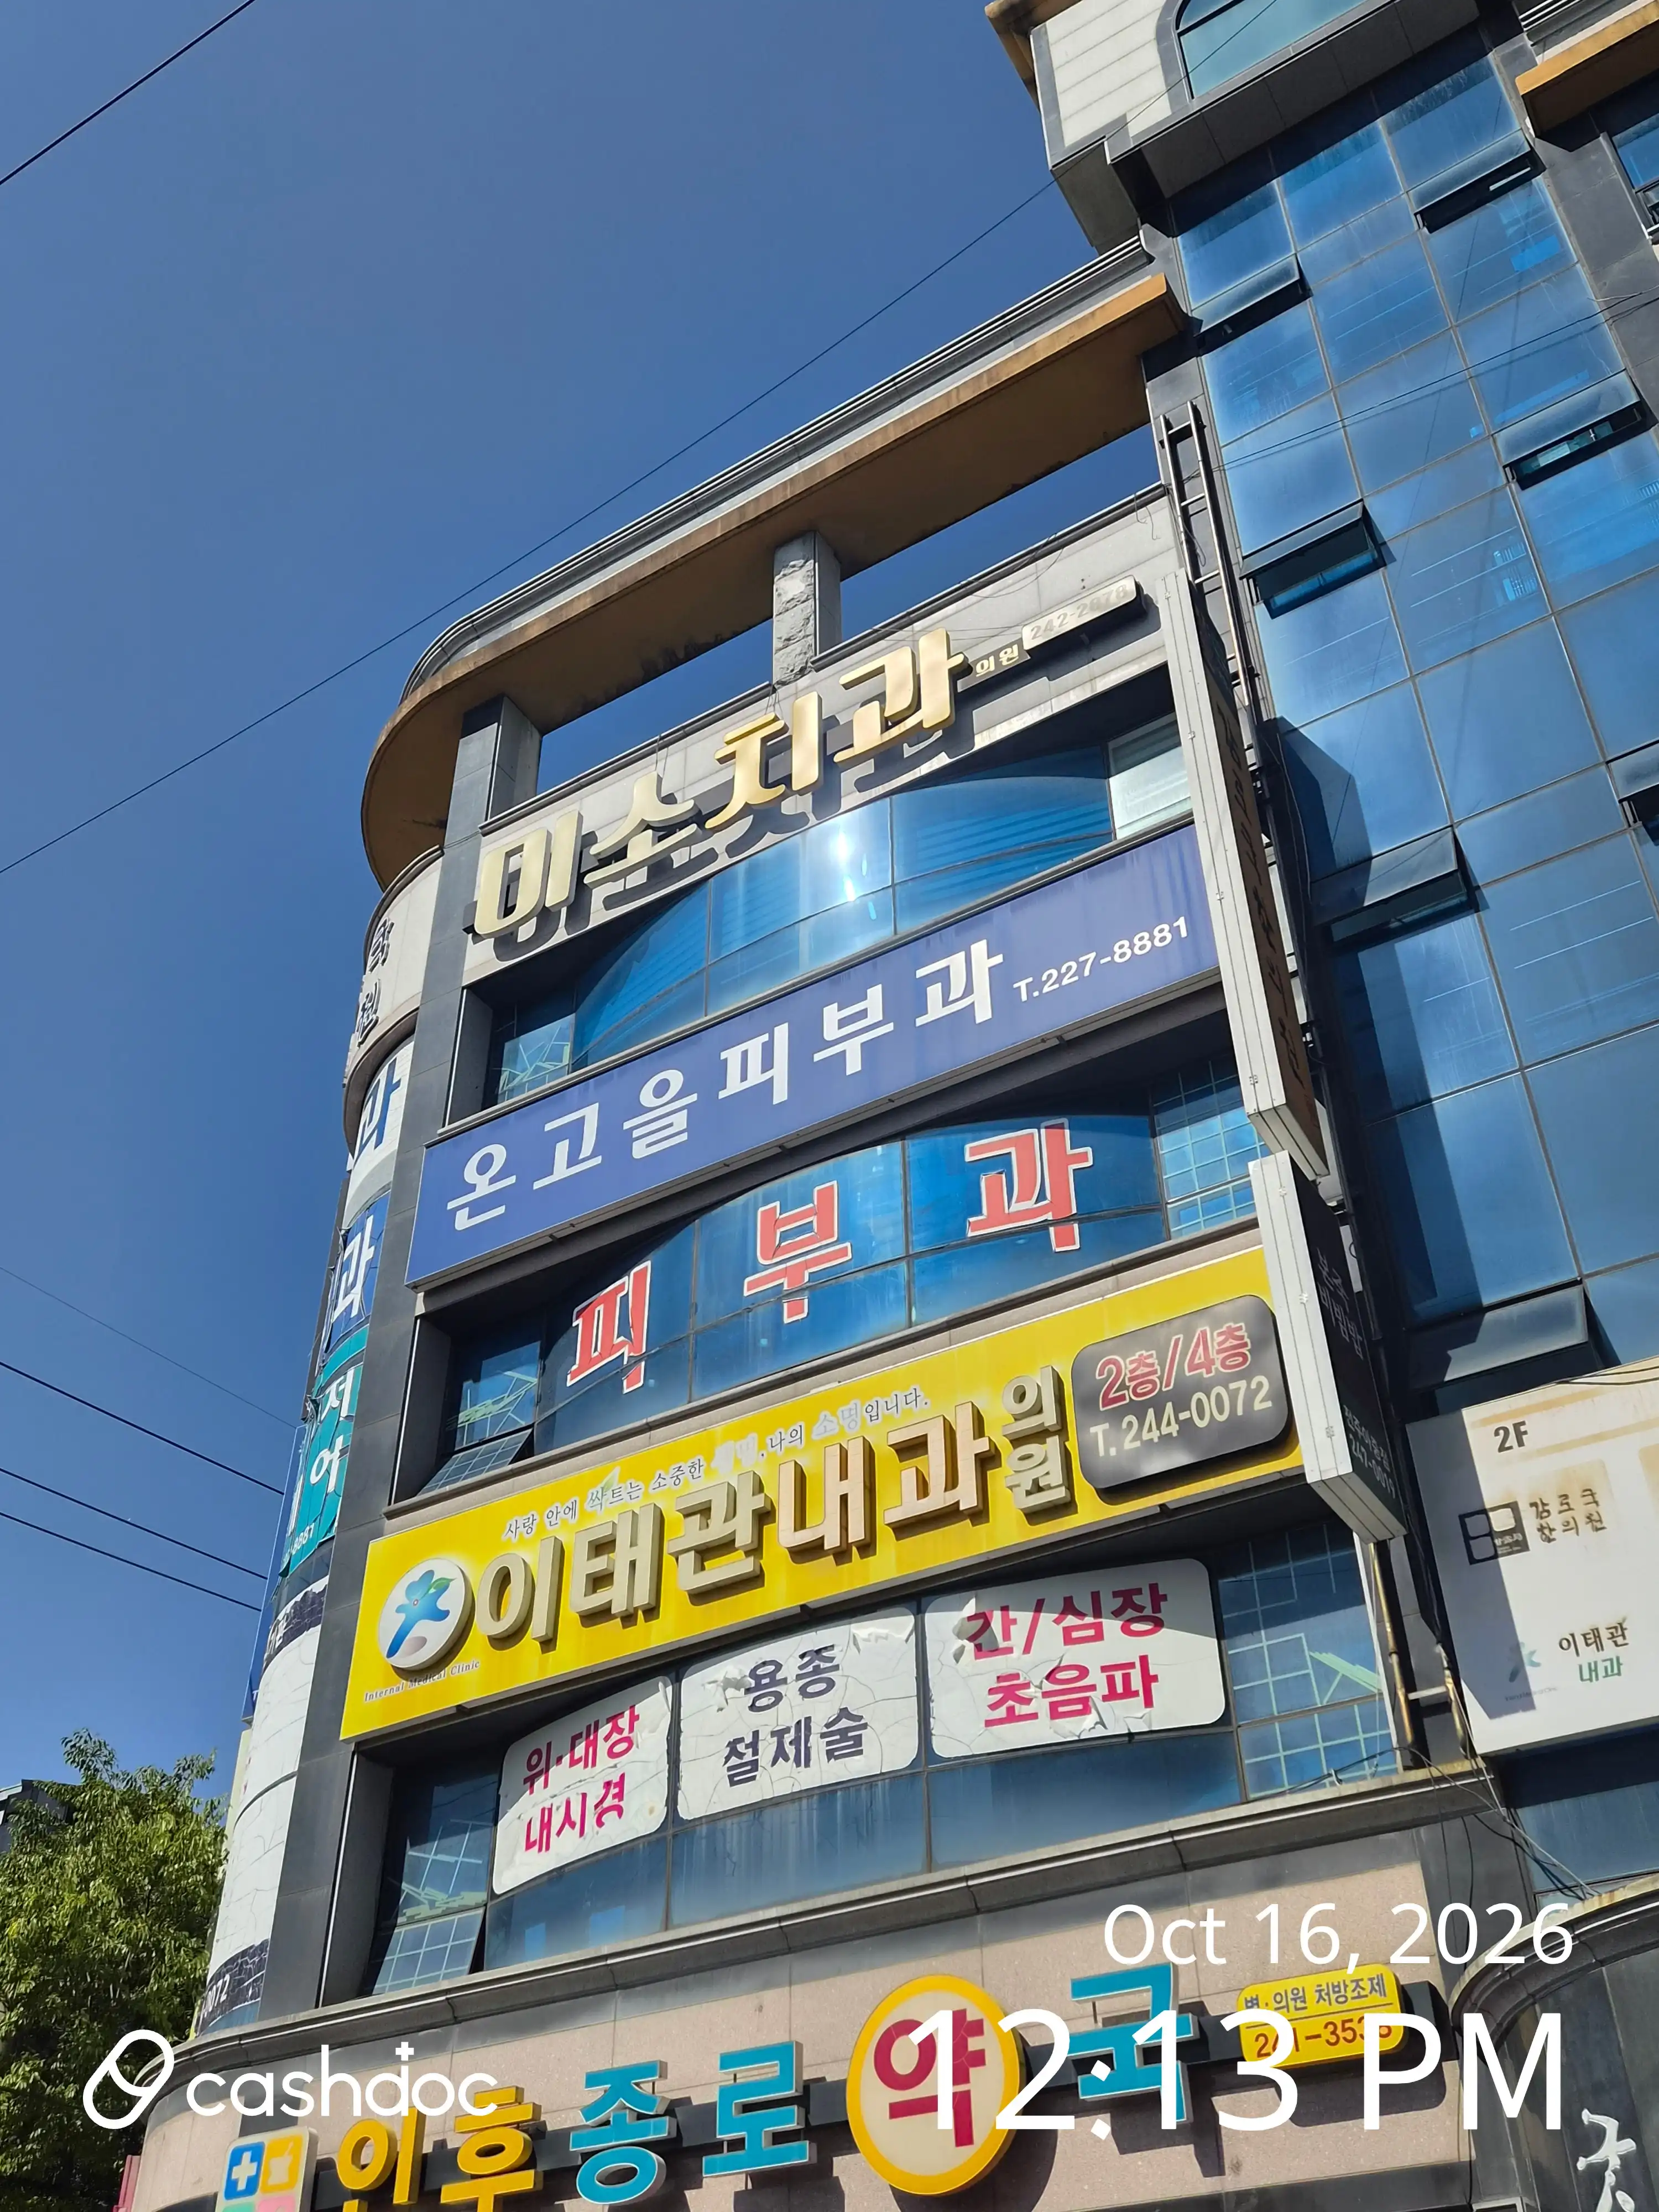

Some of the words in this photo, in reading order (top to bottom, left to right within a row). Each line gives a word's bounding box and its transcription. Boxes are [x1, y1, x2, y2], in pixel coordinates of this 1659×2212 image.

[473, 627, 974, 938] 미소치과
[975, 645, 1019, 677] 의원
[447, 938, 1004, 1232] 온고을피부과
[566, 1118, 1093, 1394] 피부과
[1096, 1321, 1251, 1411] 2층/4층
[1494, 1420, 1528, 1453] 2F
[474, 1402, 997, 1642] 이태관내과
[505, 1514, 538, 1540] 사랑
[546, 1500, 577, 1527] 안에
[651, 1458, 705, 1491] 소중한
[1536, 1511, 1608, 1543] 한의원
[966, 1583, 1168, 1661] 간/심장
[1558, 1621, 1630, 1657] 이태관
[364, 1682, 405, 1702] Internal
[409, 1668, 446, 1689] Medical
[450, 1660, 480, 1676] Clinic
[744, 1644, 840, 1713] 용종
[984, 1654, 1159, 1728] 초음파
[1578, 1656, 1624, 1683] 내과
[524, 1772, 626, 1854] 내시경
[1315, 1973, 1387, 2006] 처방조제
